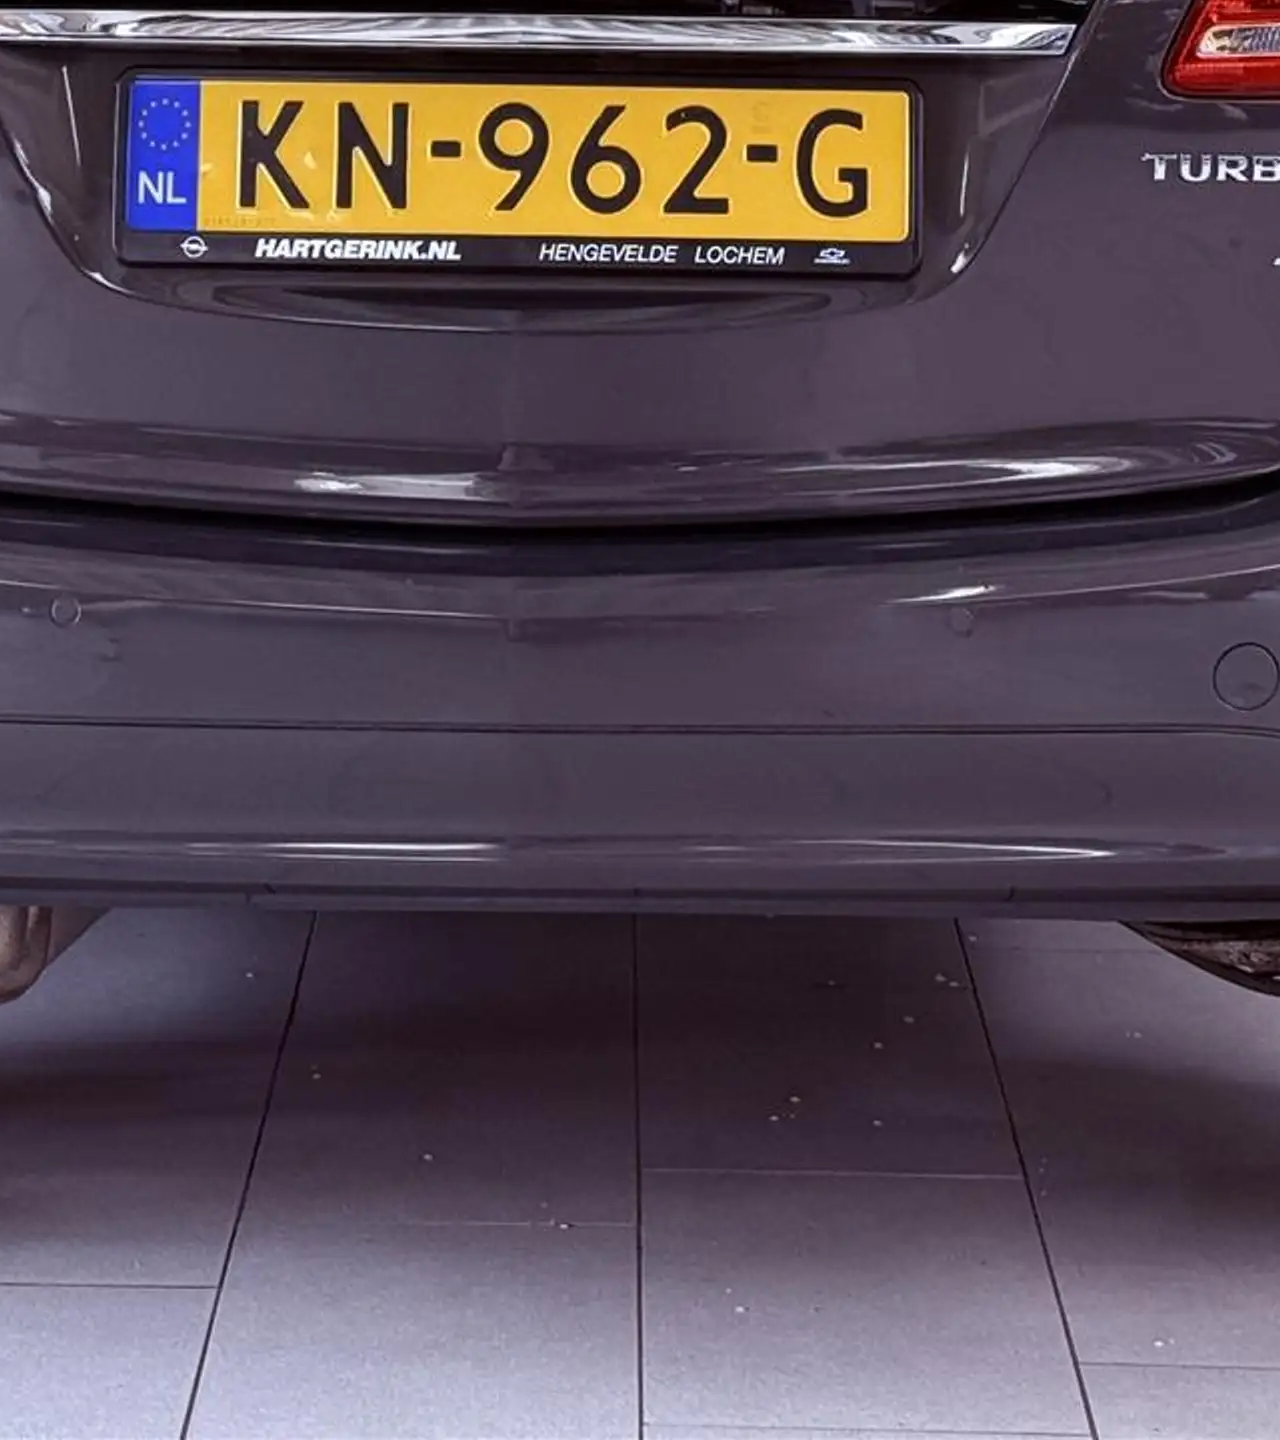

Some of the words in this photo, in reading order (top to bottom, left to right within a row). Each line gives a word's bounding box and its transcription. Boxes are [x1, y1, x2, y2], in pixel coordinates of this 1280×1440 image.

[235, 99, 870, 219] KN-962-G
[137, 170, 188, 204] NL
[253, 237, 463, 261] HARTGERINK.NL
[538, 242, 679, 264] HENGEVELDE
[693, 244, 786, 266] LOCHEM
